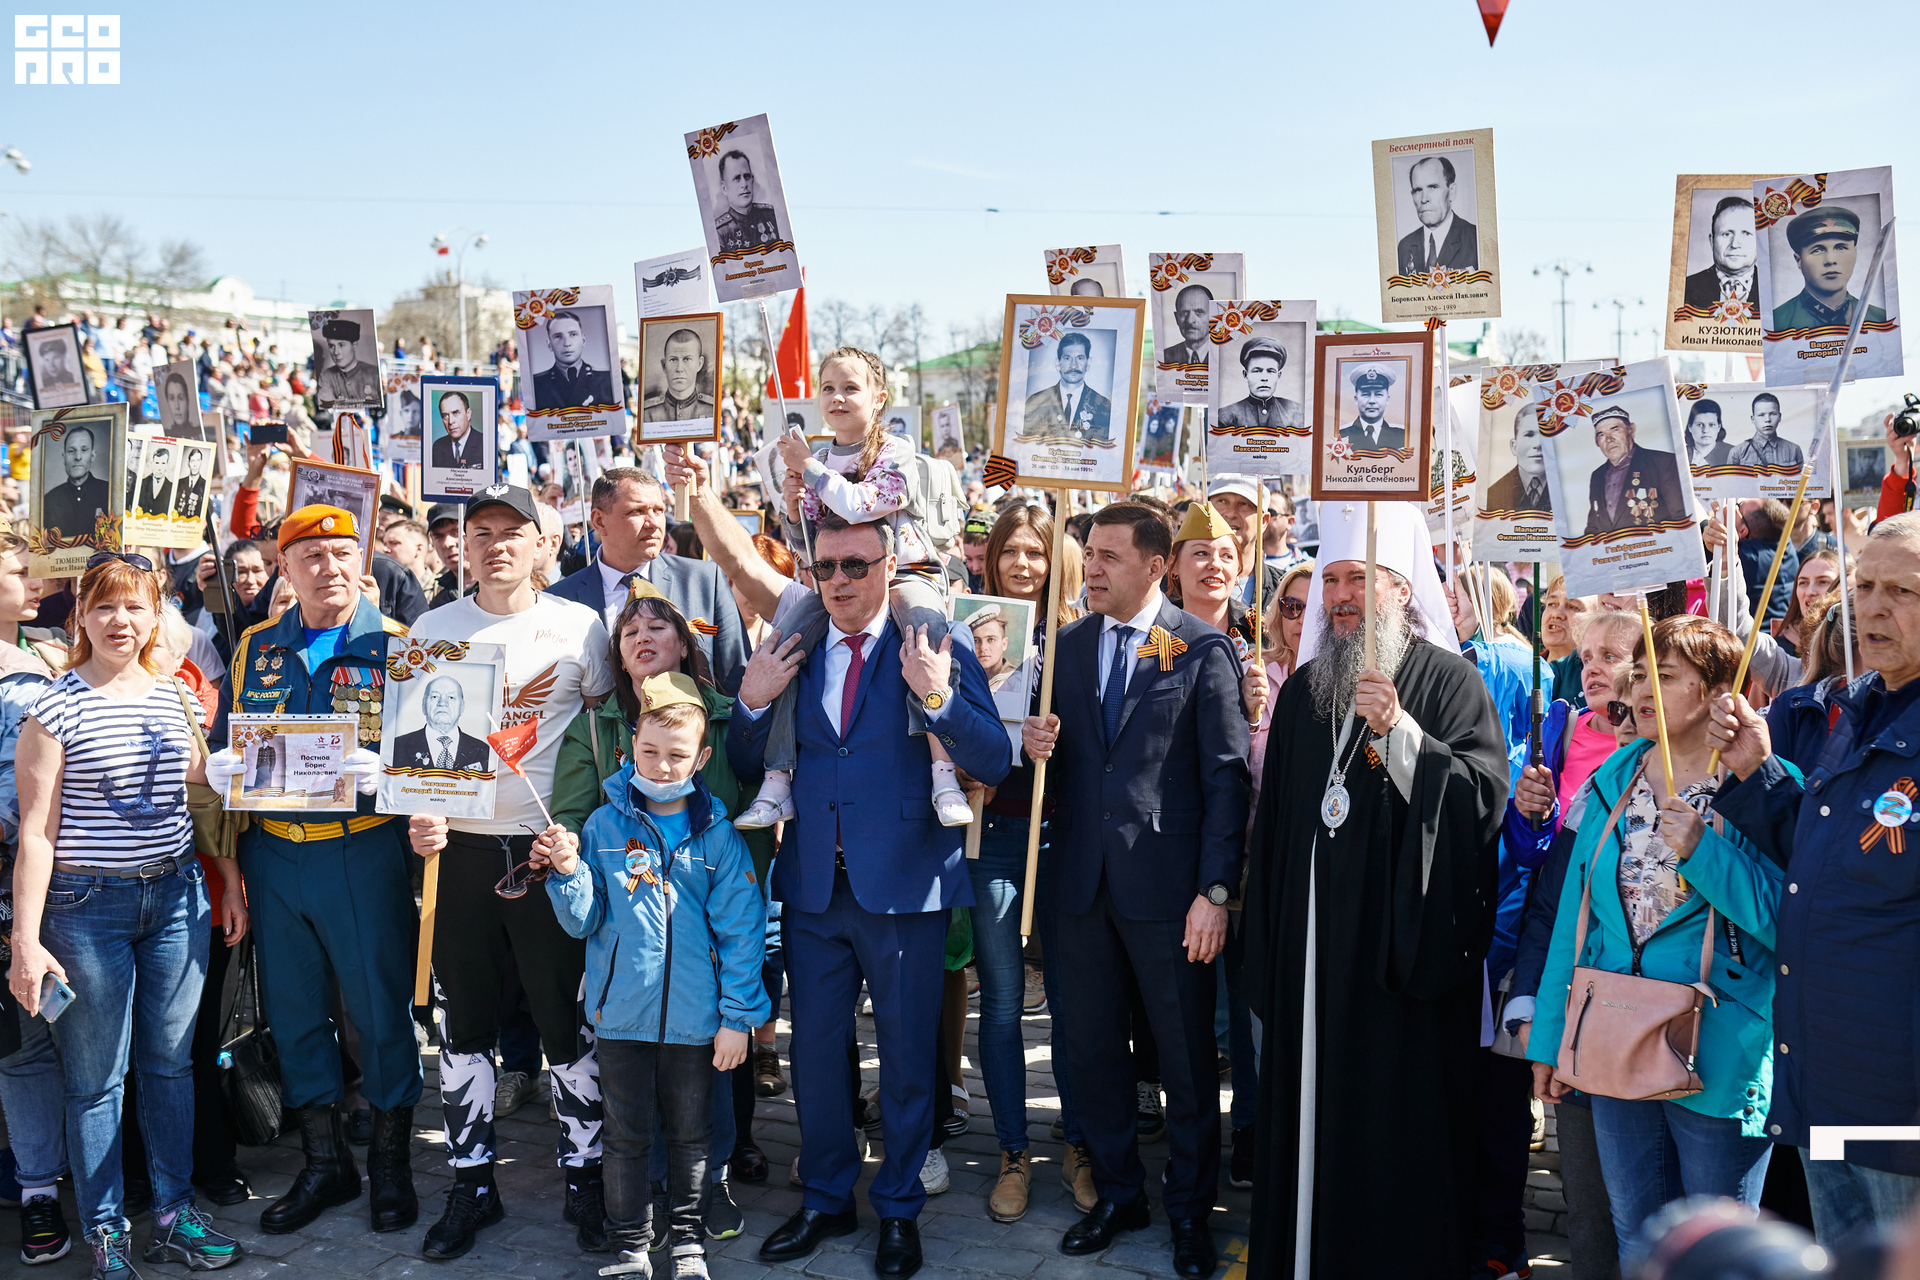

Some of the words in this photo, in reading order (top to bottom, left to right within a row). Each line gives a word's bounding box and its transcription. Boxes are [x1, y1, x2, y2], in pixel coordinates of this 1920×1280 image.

[1389, 139, 1450, 153] Бессмертный
[1453, 138, 1474, 146] полк
[744, 260, 764, 268] Орлов
[1698, 326, 1761, 336] КУЗЮТКИН
[1681, 335, 1708, 344] Иван
[1797, 349, 1838, 359] Григорий
[1031, 455, 1057, 464] Леонид
[1057, 456, 1097, 465] Васильевич
[1346, 465, 1395, 475] Кульберг
[1325, 475, 1363, 483] Николай
[1365, 474, 1415, 483] Семёнович
[1497, 533, 1526, 541] Филипп
[1605, 540, 1657, 554] Гайфуллин
[1623, 546, 1673, 560] Галимович
[1618, 561, 1649, 570] старшина
[246, 690, 260, 698] МЧС
[260, 690, 281, 698] РОССИИ
[502, 710, 547, 720] ANGEL
[500, 721, 526, 731] HA
[433, 788, 478, 796] Николаевич
